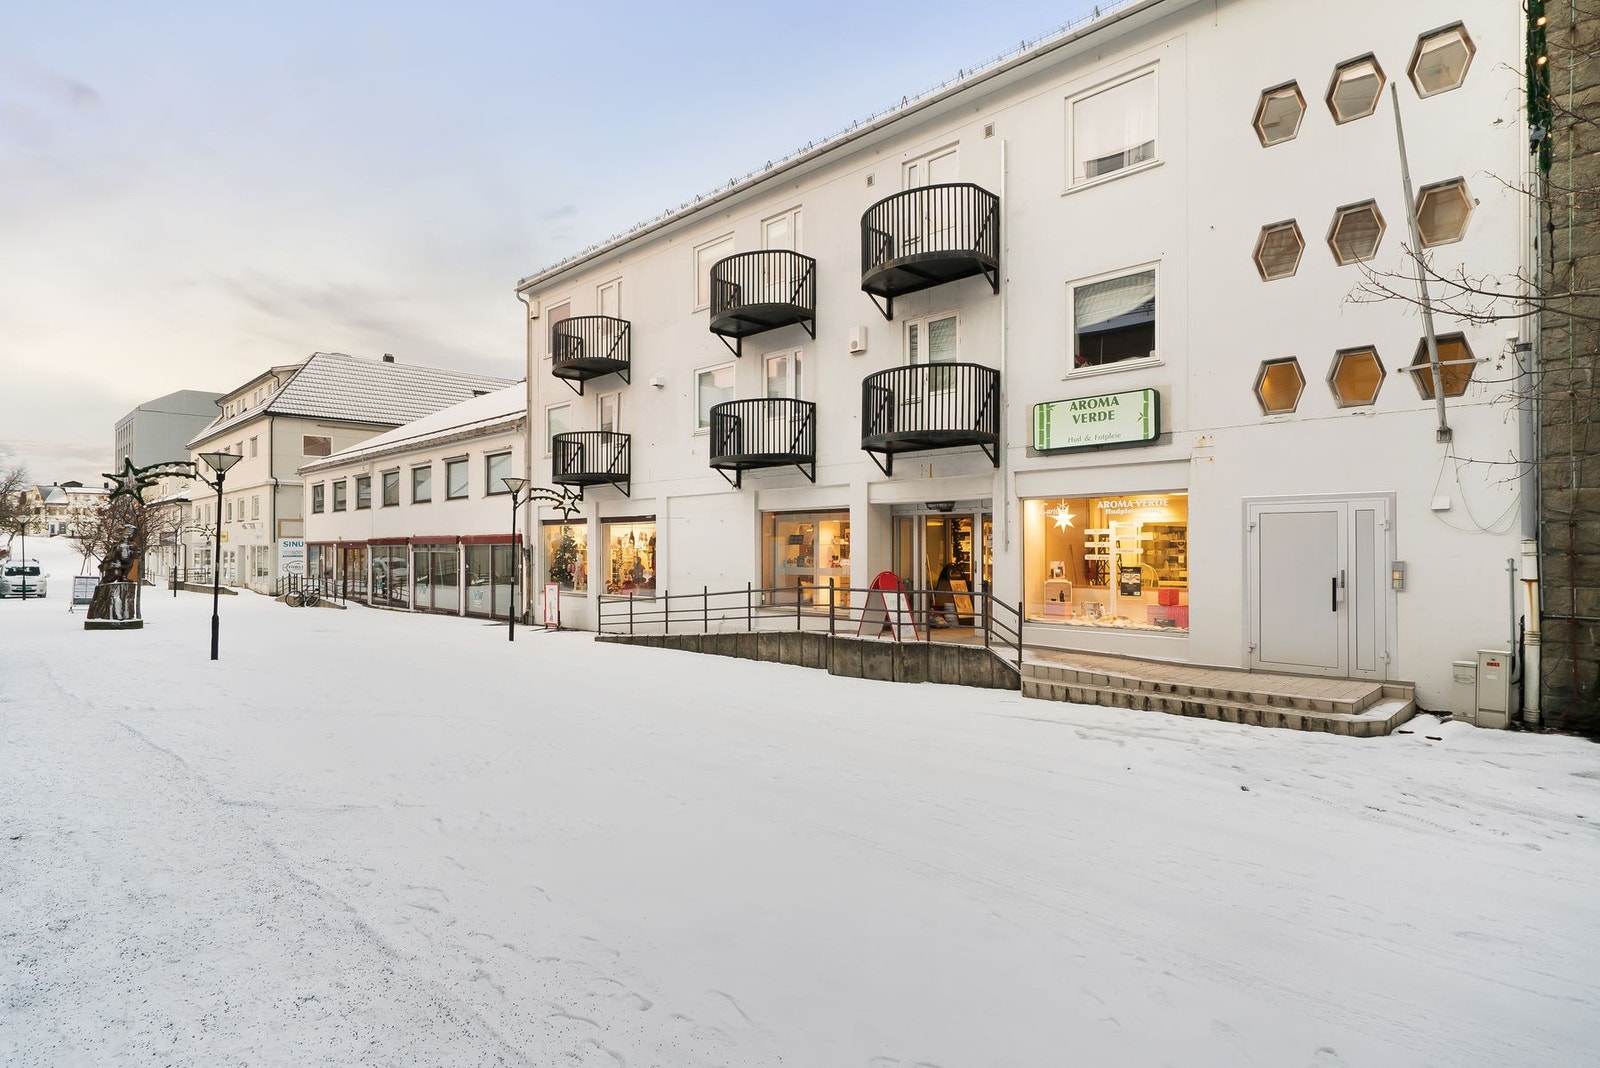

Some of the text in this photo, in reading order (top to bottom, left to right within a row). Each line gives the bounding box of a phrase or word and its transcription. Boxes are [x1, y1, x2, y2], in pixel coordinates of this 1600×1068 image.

[1070, 396, 1119, 411] AROMA
[1072, 410, 1115, 424] VERDE
[1067, 435, 1082, 443] Hud
[1097, 500, 1133, 509] AROMA
